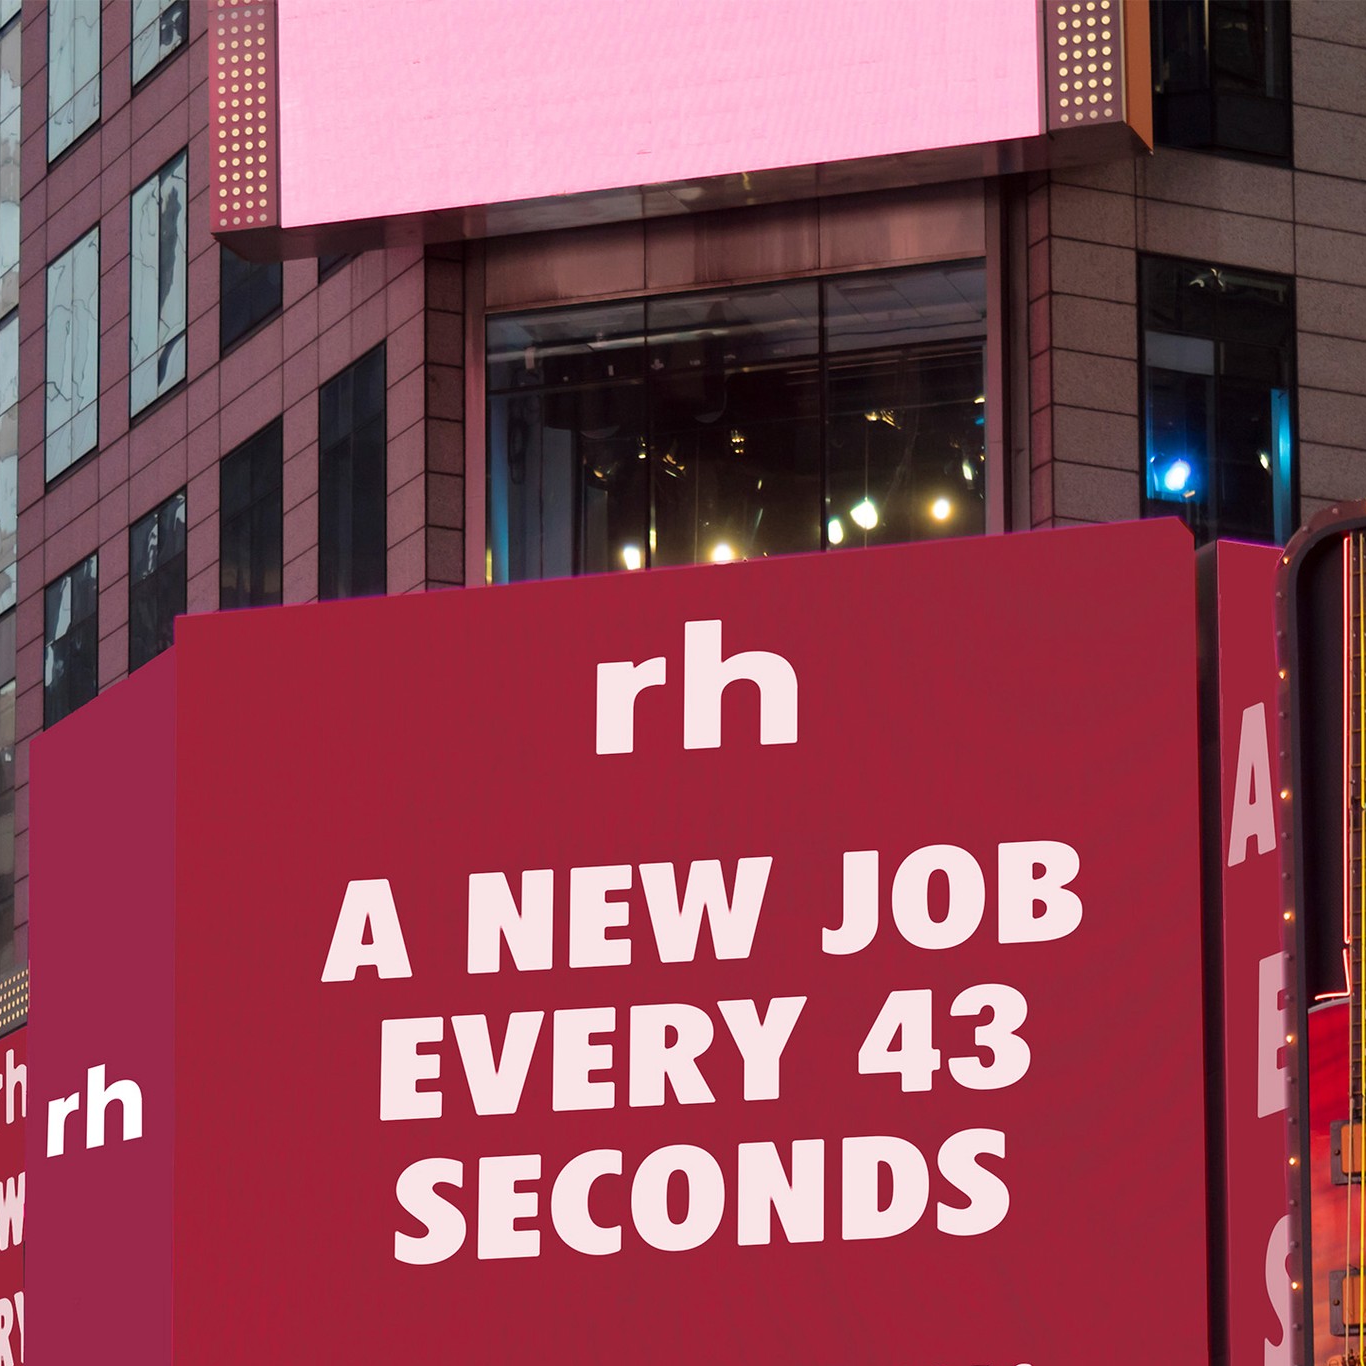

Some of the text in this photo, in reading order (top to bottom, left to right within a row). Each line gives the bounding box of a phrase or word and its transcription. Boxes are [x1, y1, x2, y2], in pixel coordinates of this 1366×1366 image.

[594, 618, 800, 757] rh
[321, 839, 1085, 985] A NEW JOB
[46, 1063, 144, 1158] rh
[379, 982, 1033, 1123] EVERY 43
[393, 1127, 1012, 1266] SECONDS
